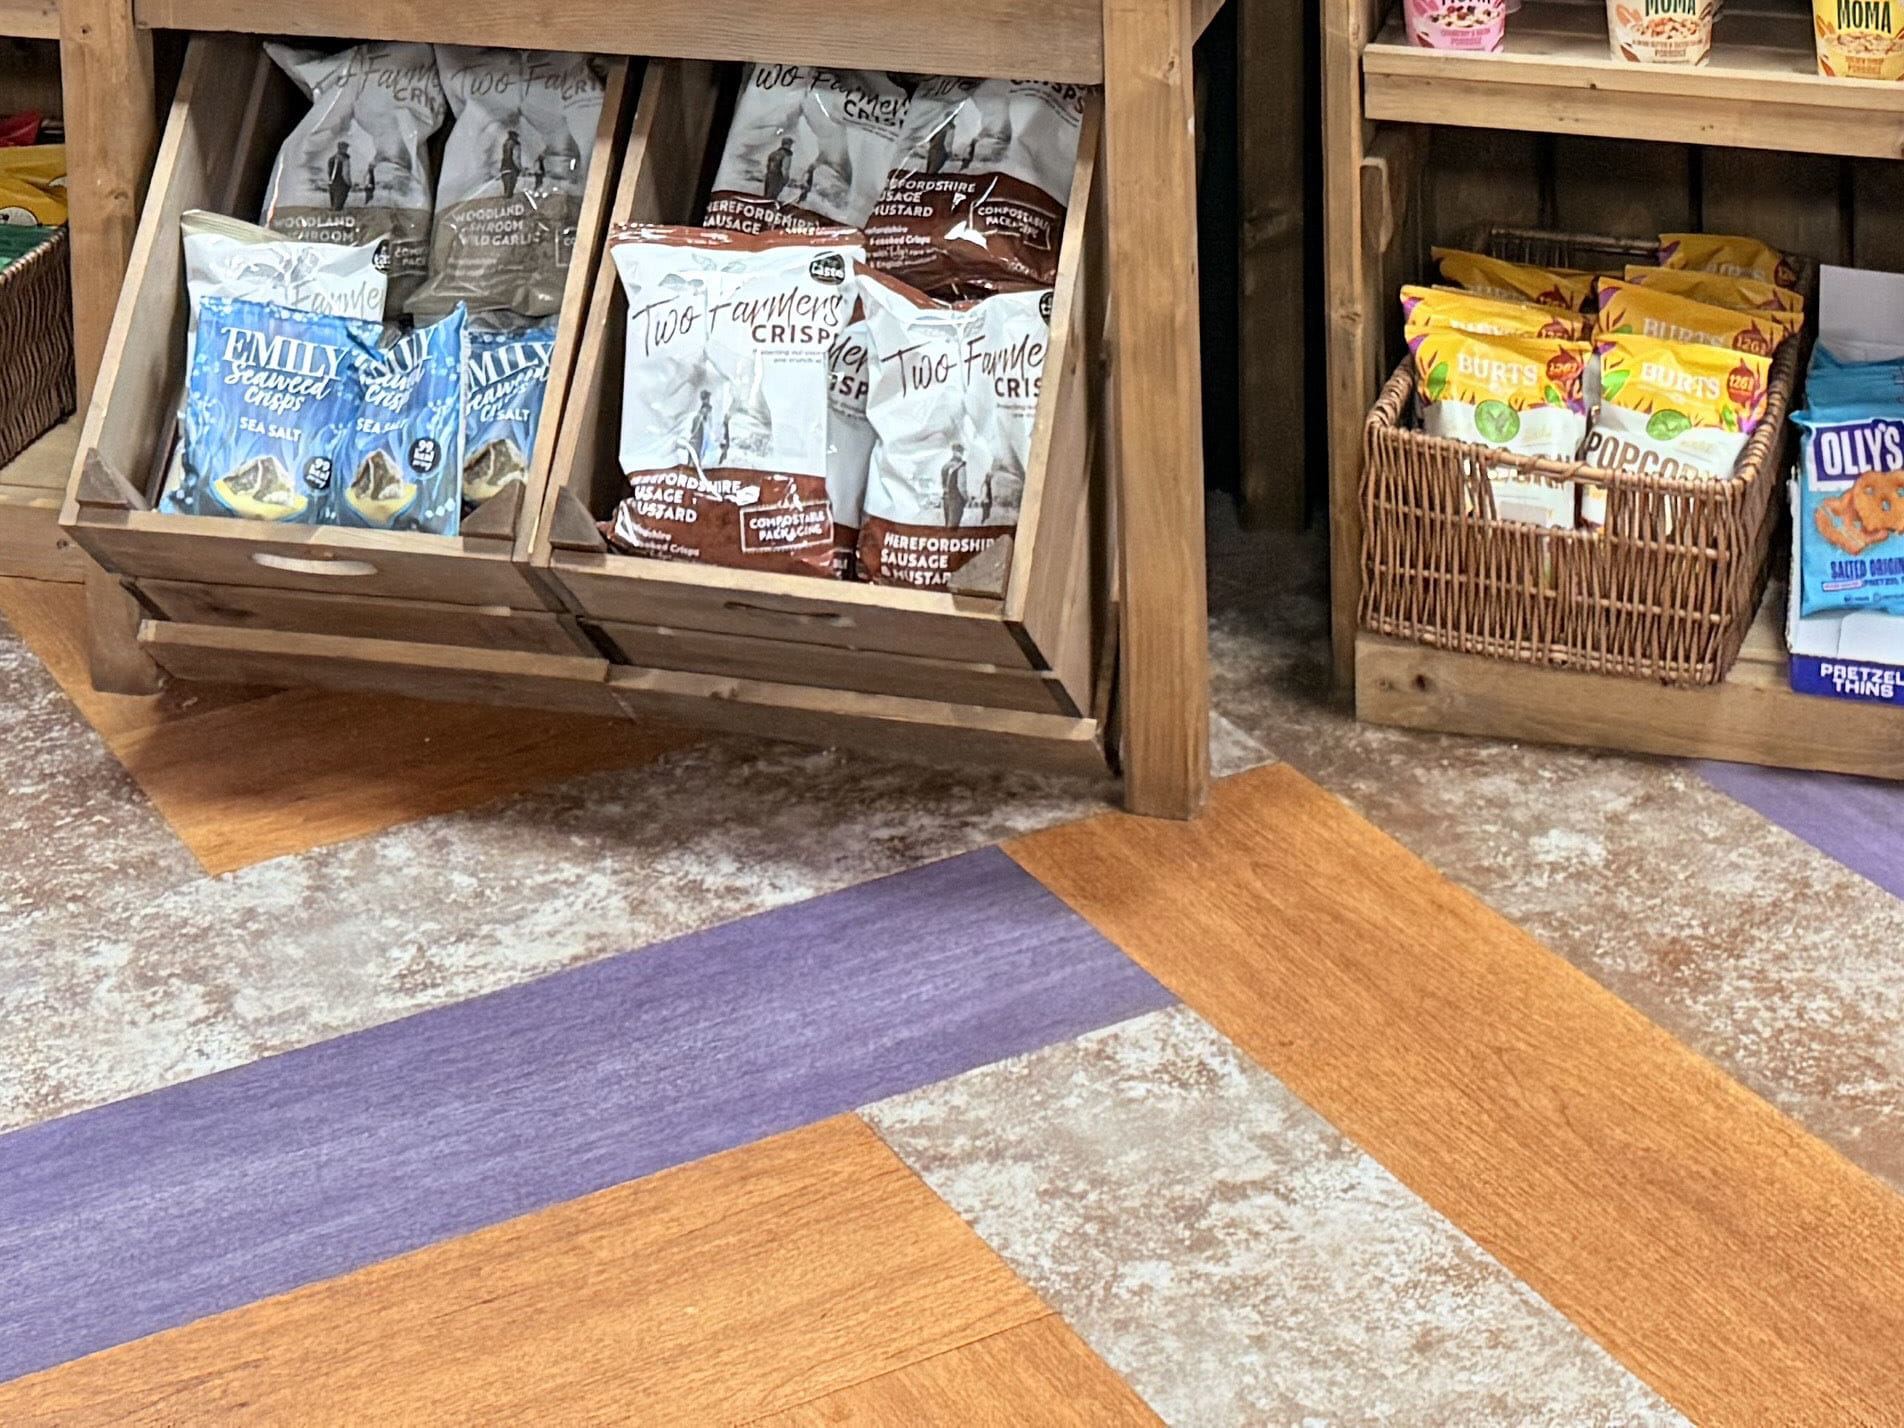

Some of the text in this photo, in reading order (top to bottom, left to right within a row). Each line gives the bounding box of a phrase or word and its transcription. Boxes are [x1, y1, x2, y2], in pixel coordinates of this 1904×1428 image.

[632, 286, 844, 358] Two Farmers
[220, 325, 350, 383] EMILY
[881, 341, 959, 399] Two
[1456, 351, 1539, 387] BURTS
[224, 359, 333, 402] Seaweed
[1640, 361, 1721, 400] BURTS
[244, 387, 306, 416] Crisps
[495, 408, 530, 422] SALT
[239, 416, 302, 442] SEA SALT
[356, 417, 381, 433] SEA
[1820, 421, 1904, 476] OLLY'S
[880, 548, 950, 570] SAUSAGE
[1829, 558, 1868, 580] SALTED
[1832, 677, 1895, 699] THINS
